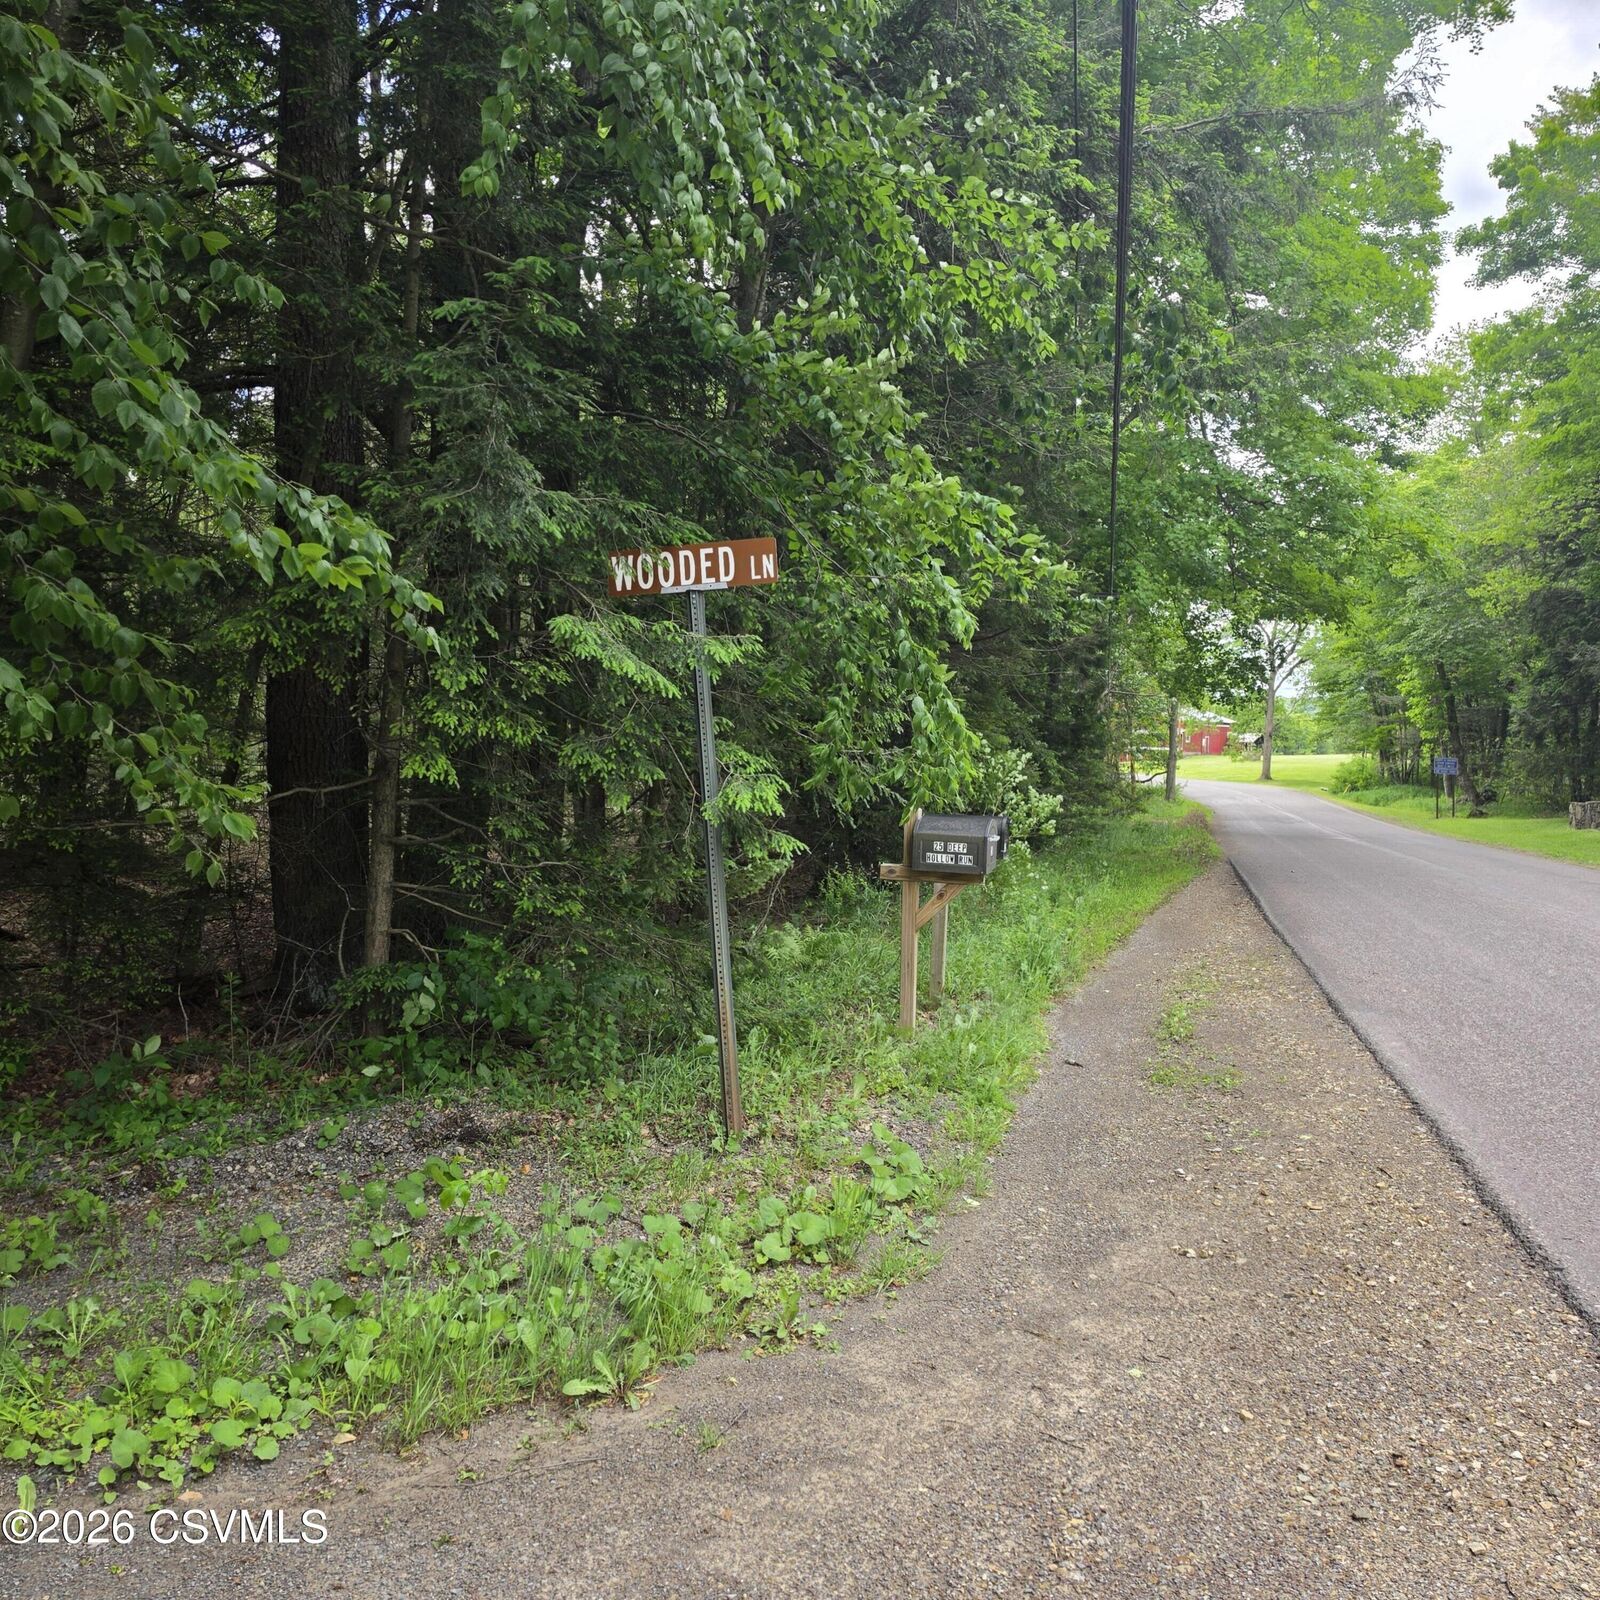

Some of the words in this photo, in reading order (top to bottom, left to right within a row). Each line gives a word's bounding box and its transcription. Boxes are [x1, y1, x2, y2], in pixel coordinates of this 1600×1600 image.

[611, 546, 735, 591] WOODED
[750, 553, 774, 580] LN
[934, 842, 943, 851] 25
[948, 843, 967, 852] DEEP
[926, 854, 955, 864] HOLLOW
[958, 855, 973, 865] RUN
